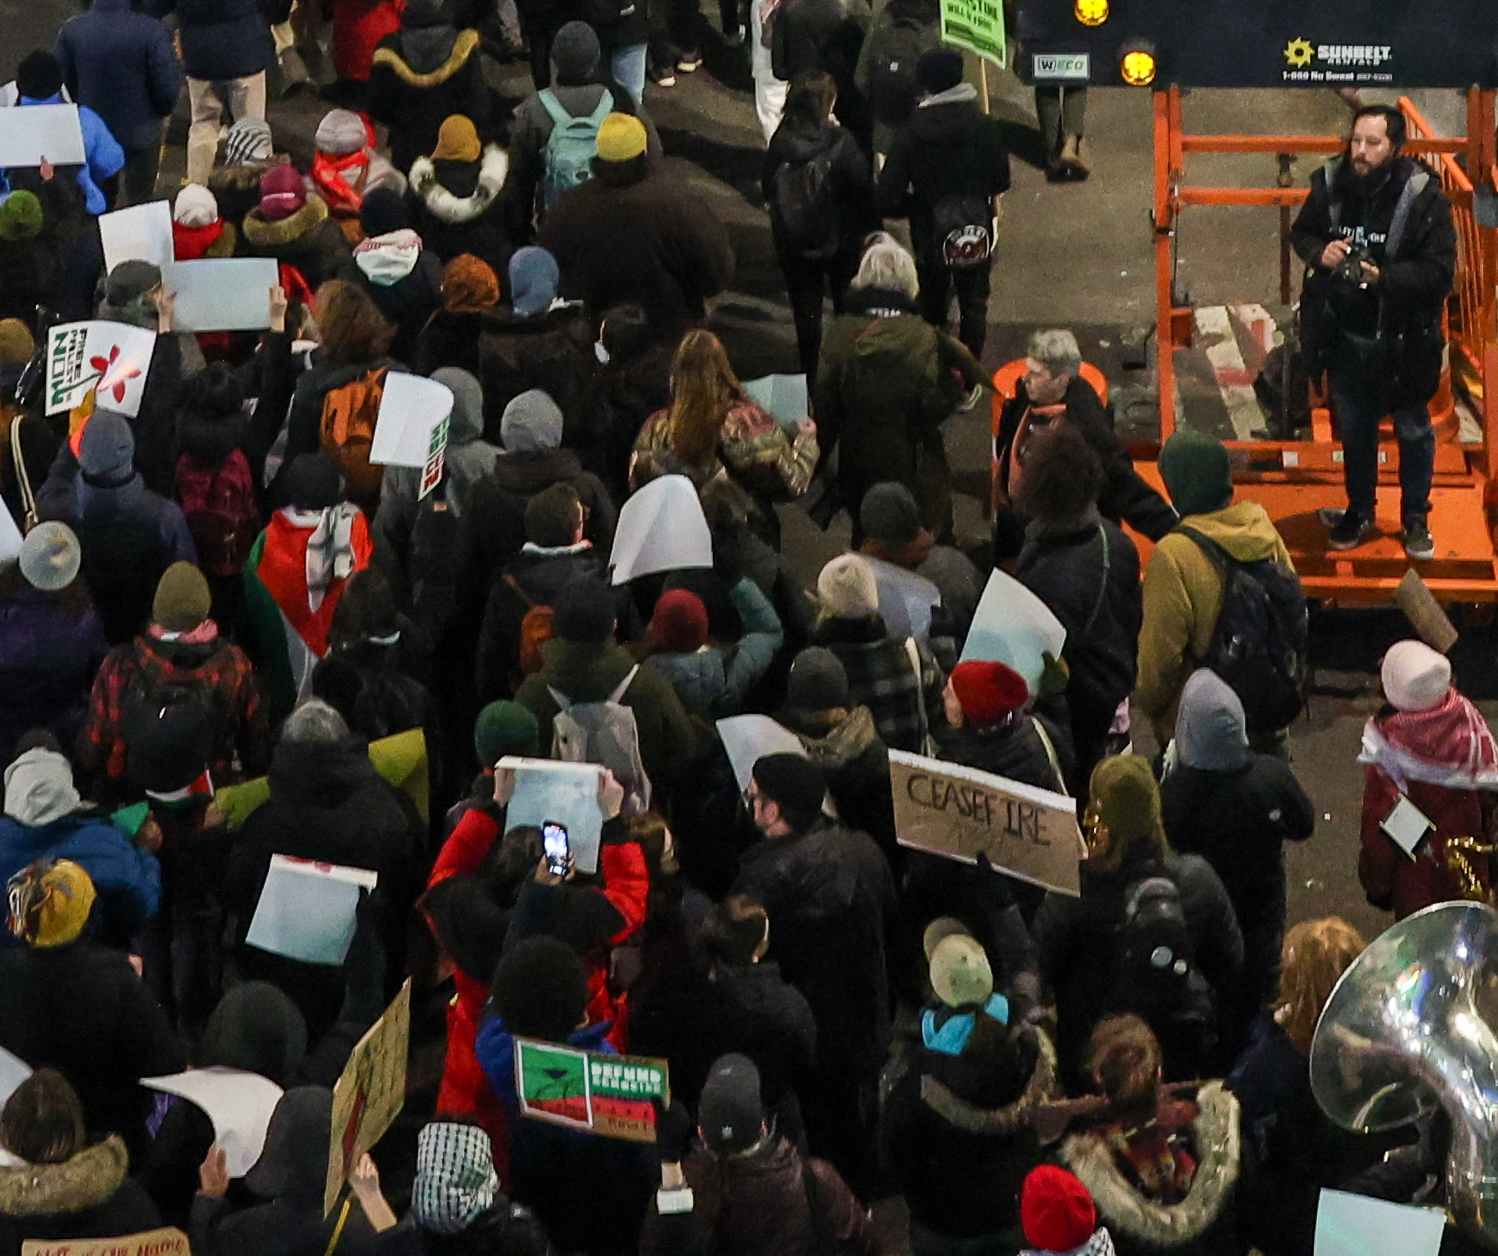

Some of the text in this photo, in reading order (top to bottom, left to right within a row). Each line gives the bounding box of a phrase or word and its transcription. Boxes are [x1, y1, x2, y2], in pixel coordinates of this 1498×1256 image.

[1317, 45, 1391, 60] SUNBELT
[74, 326, 89, 381] FREE
[907, 773, 1052, 848] CEASEFIRE
[590, 1061, 662, 1084] DEFUND
